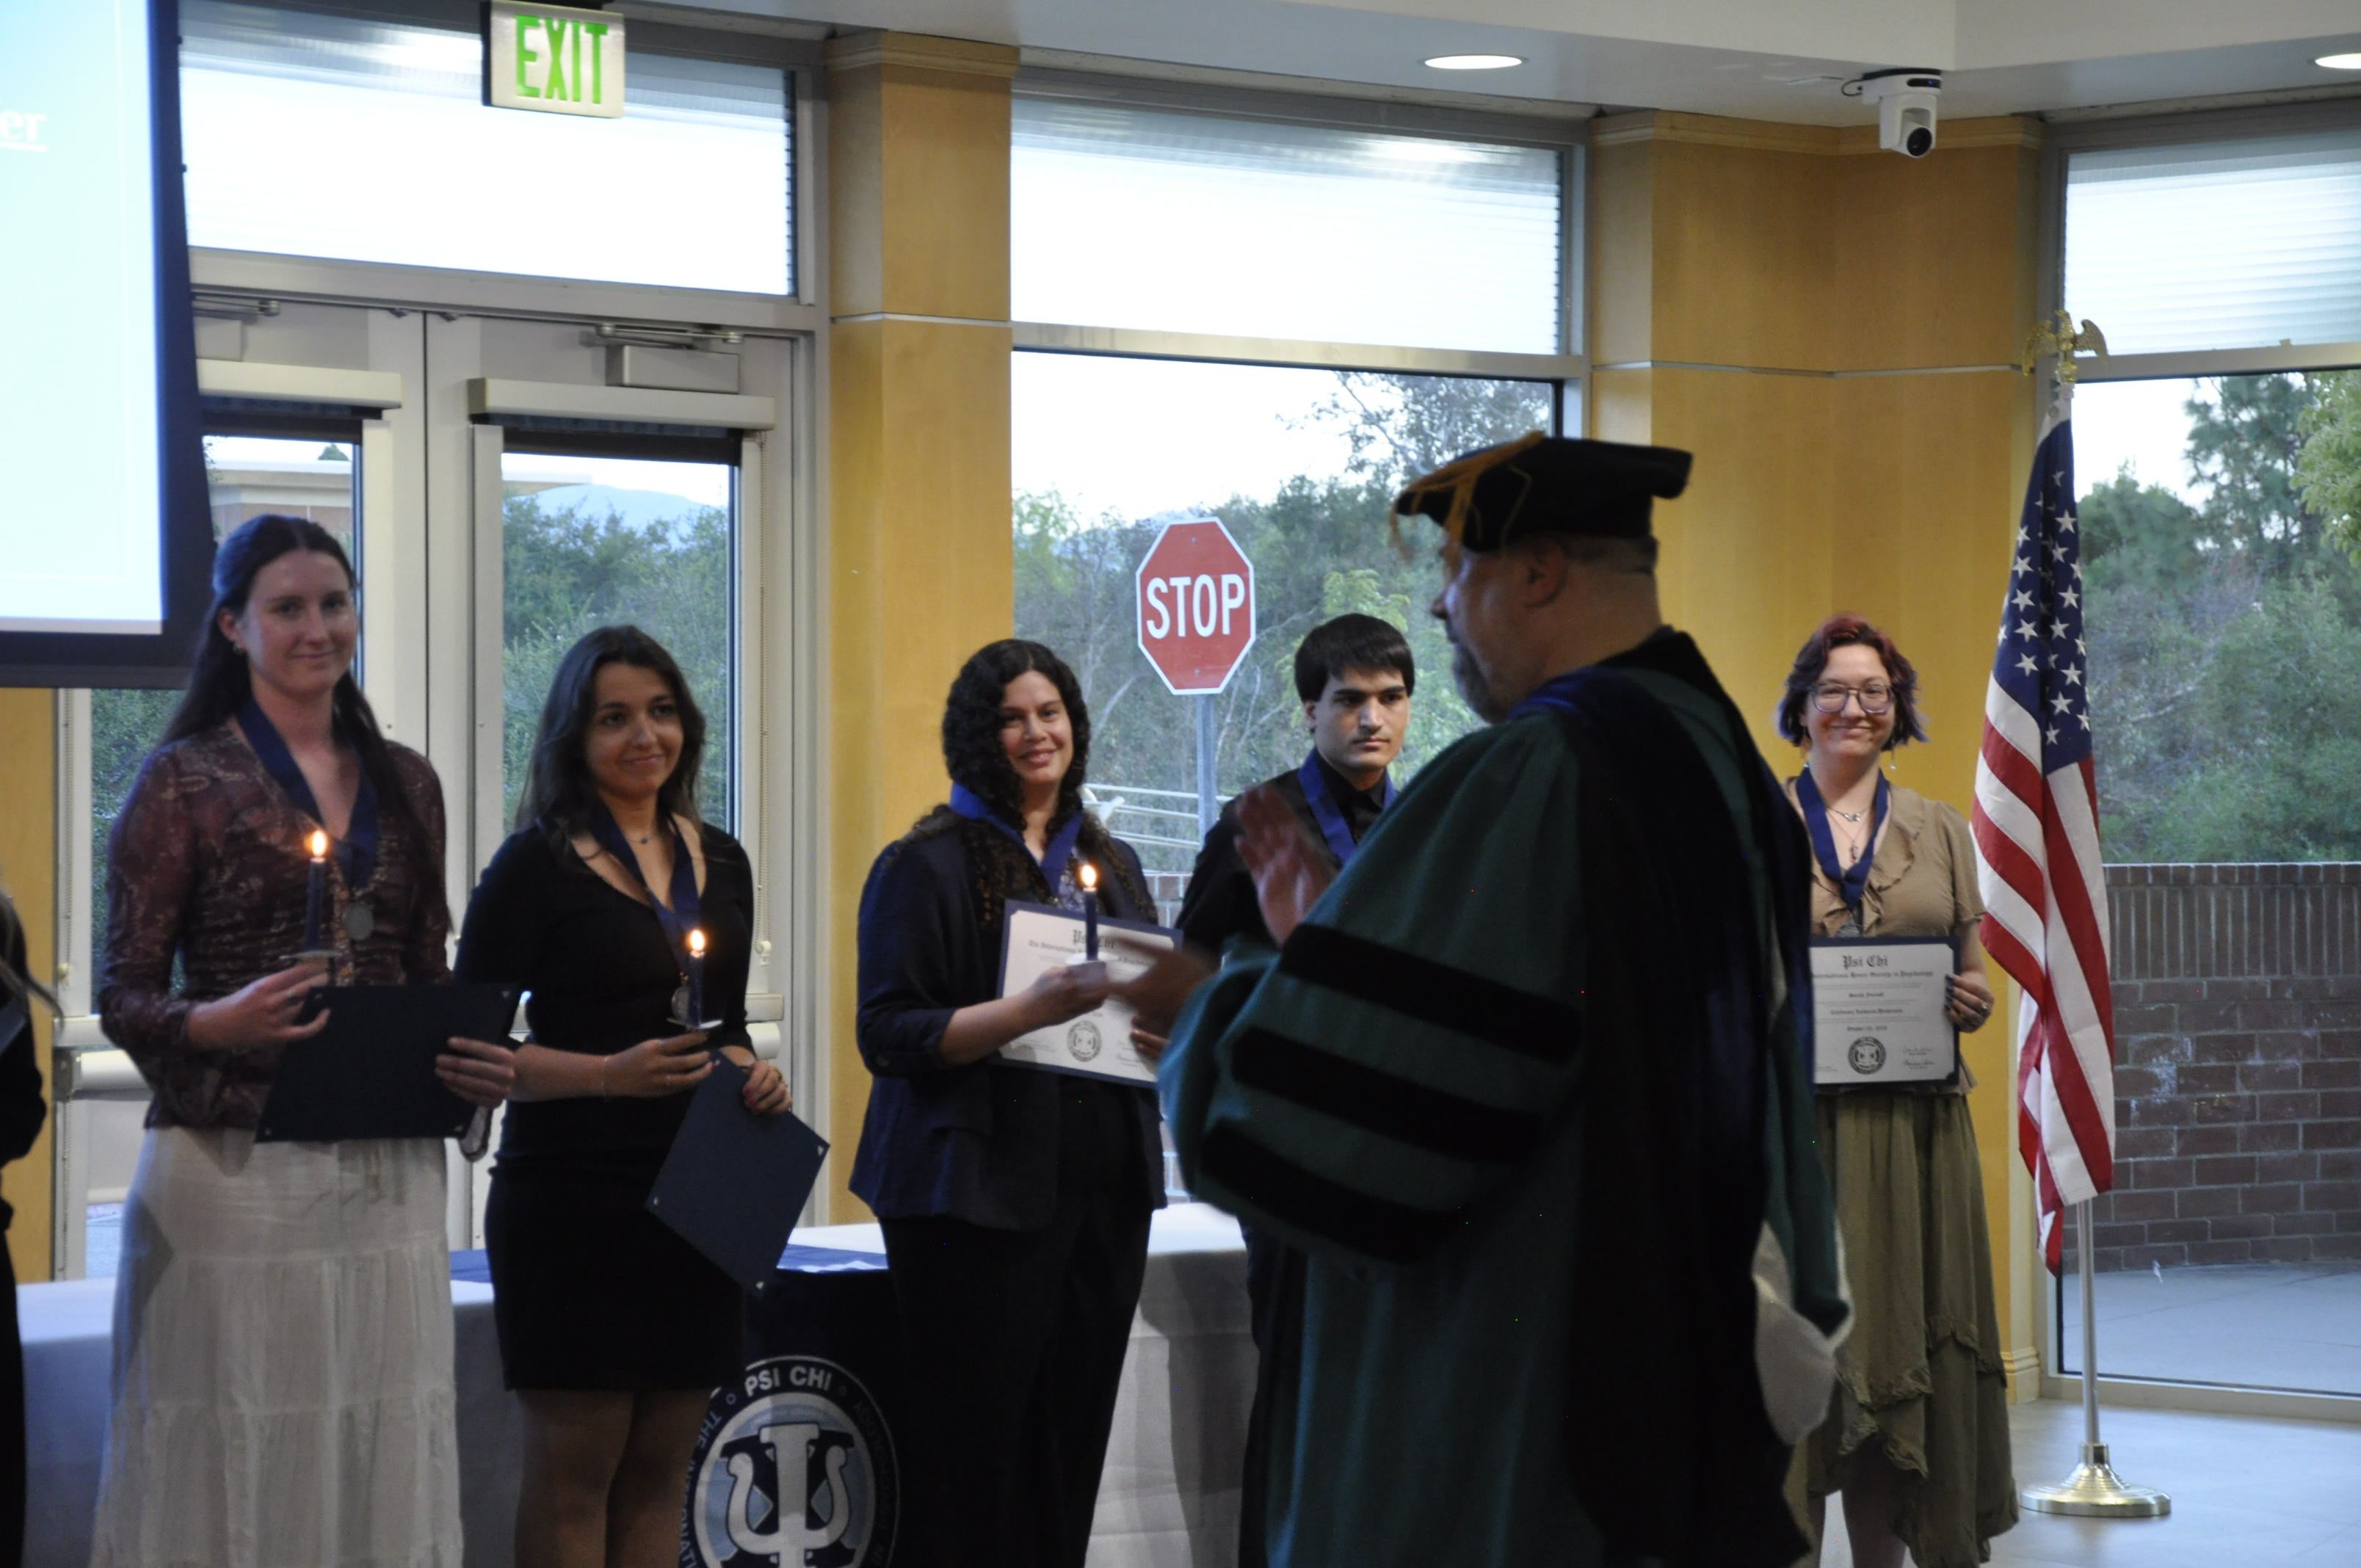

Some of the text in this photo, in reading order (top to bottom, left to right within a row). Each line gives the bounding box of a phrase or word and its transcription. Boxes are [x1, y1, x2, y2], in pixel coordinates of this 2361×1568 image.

[516, 14, 609, 104] EXIT
[1146, 573, 1245, 639] STOP
[1843, 955, 1888, 970] Psi Chi
[744, 1365, 833, 1397] PSI CHI
